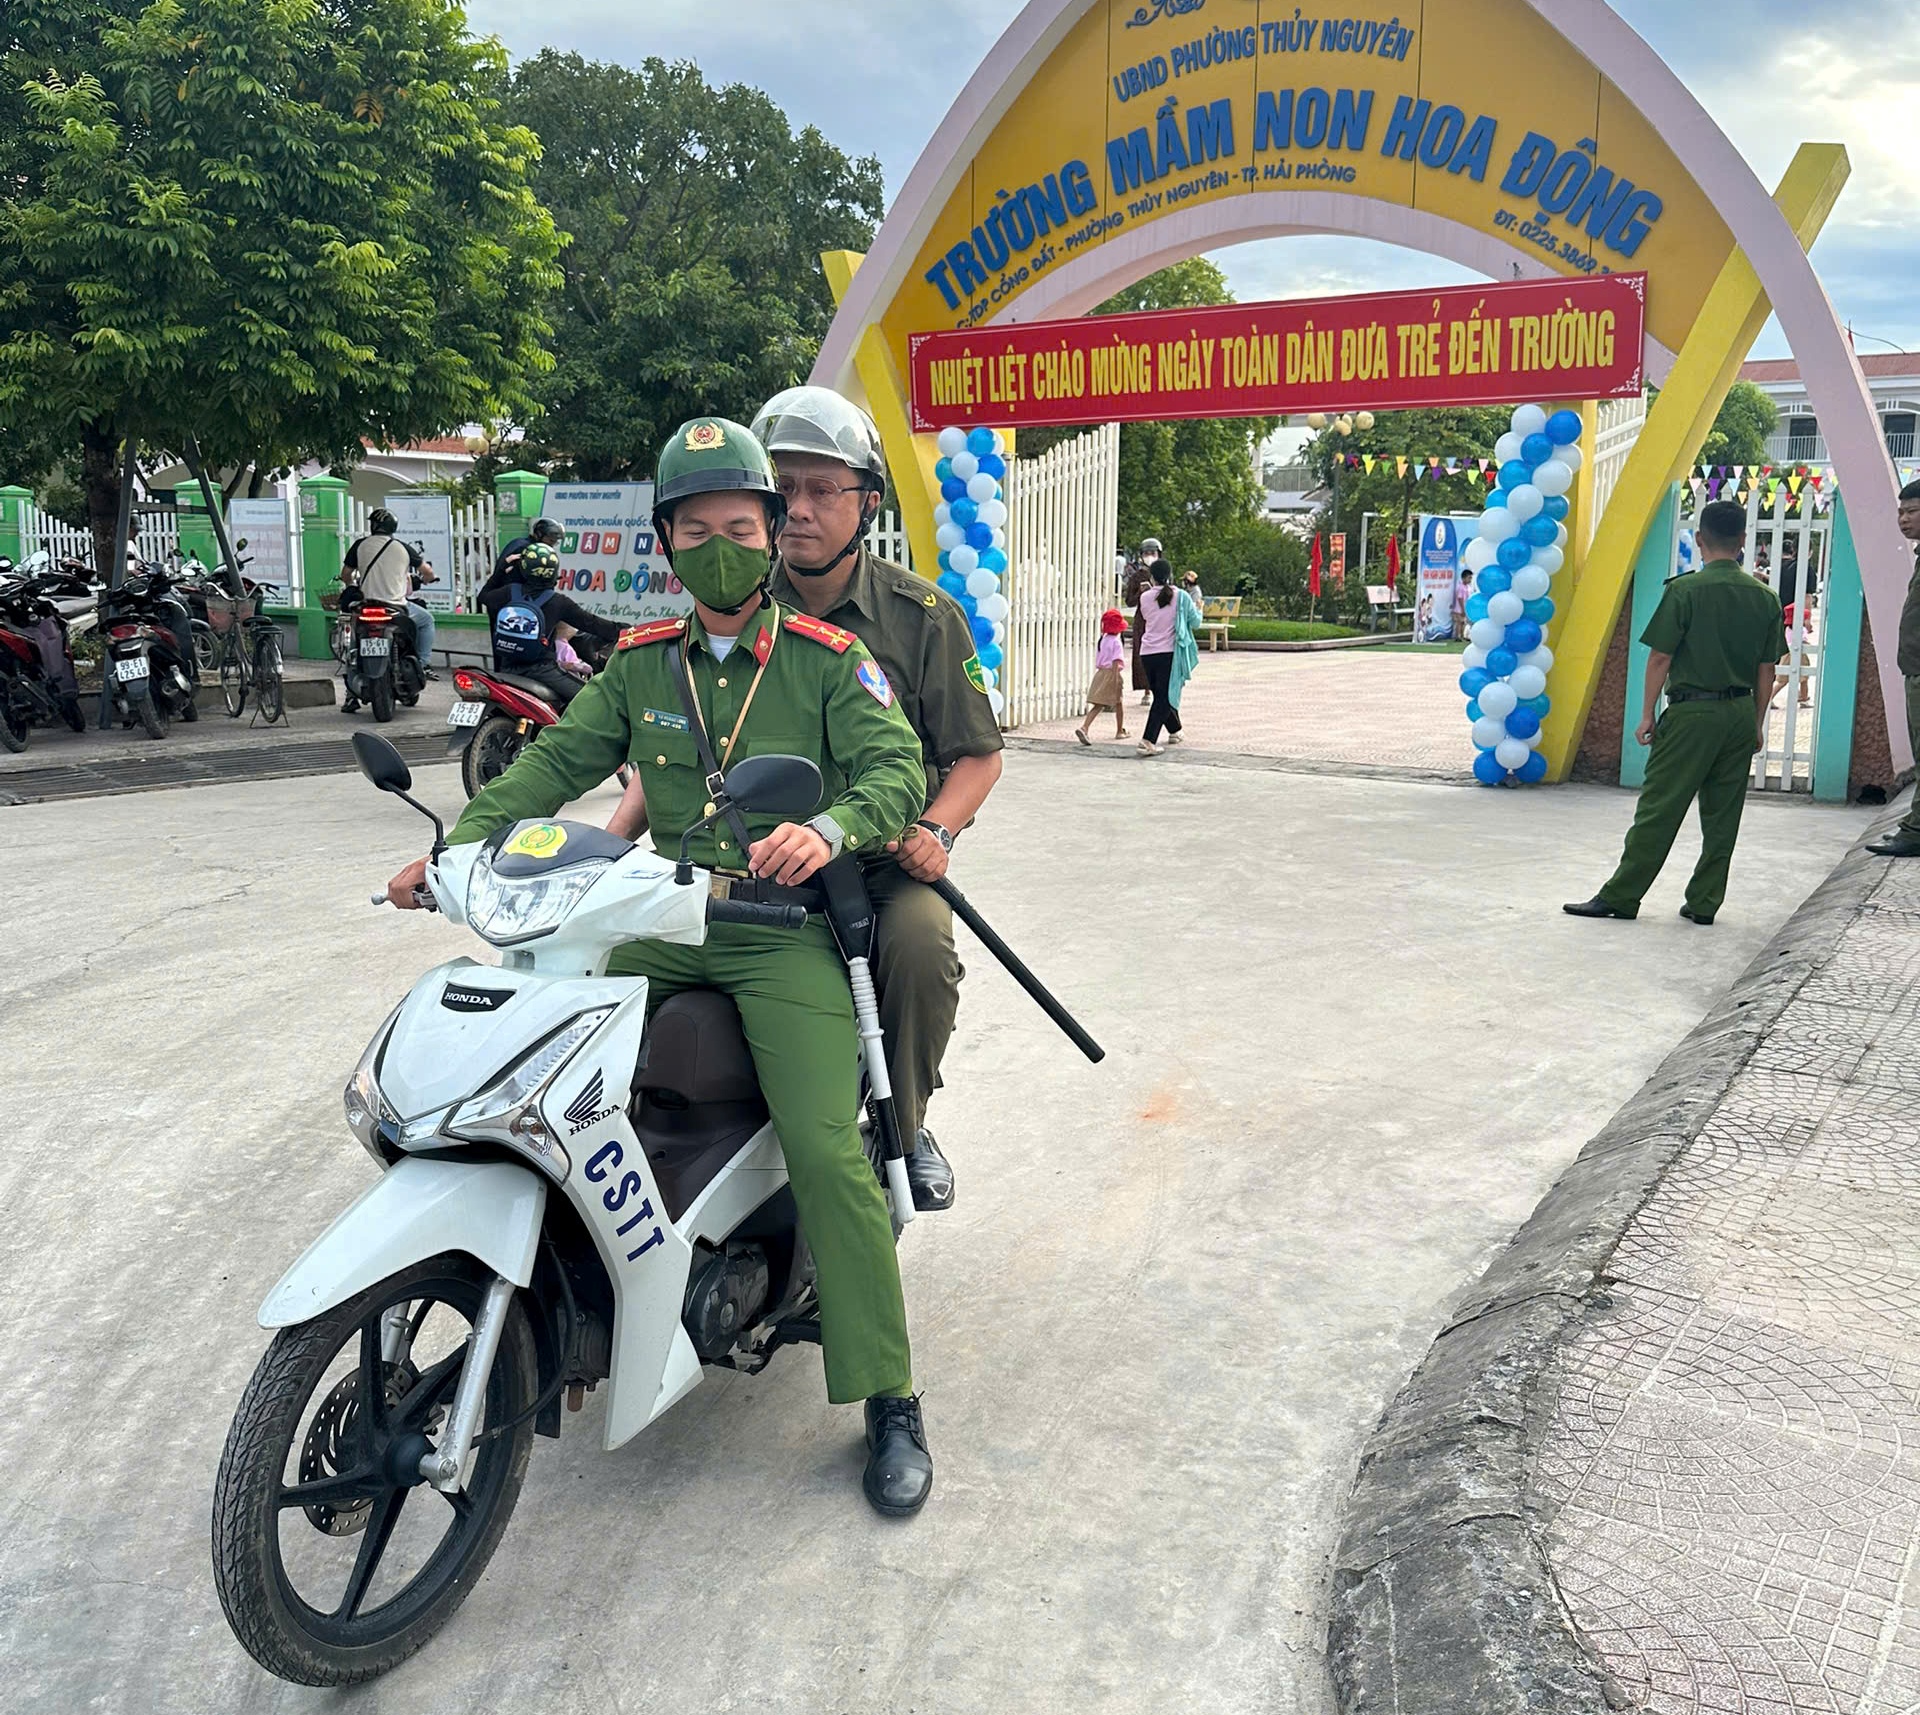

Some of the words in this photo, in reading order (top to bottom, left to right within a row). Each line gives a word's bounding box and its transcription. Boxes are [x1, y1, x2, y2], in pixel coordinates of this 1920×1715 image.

[1112, 56, 1168, 102] UBND
[1170, 26, 1256, 77] PHƯỜNG
[1260, 9, 1318, 54] THỦY
[1319, 17, 1415, 62] NGUYÊN
[924, 159, 1098, 311] TRƯỜNG
[1106, 96, 1235, 197] MẦM
[1254, 87, 1374, 152] NON
[1380, 94, 1497, 183] HOA
[1500, 131, 1663, 259] ĐỘNG
[1064, 212, 1124, 251] PHƯỜNG
[1127, 192, 1162, 219] THỦY
[1165, 170, 1229, 204] NGUYÊN
[1263, 158, 1292, 180] HẢI
[1296, 157, 1356, 183] PHÒNG
[1493, 209, 1518, 232] ĐT:
[930, 347, 984, 415] NHIỆT
[988, 344, 1028, 413] LIỆT
[1032, 339, 1085, 401] CHÀO
[1091, 333, 1151, 396] MỪNG
[1158, 329, 1216, 392] NGÀY
[1221, 324, 1279, 388] TOÀN
[1285, 320, 1334, 385] DÂN
[1340, 321, 1389, 382] ĐƯA
[1396, 300, 1441, 378] TRẺ
[1448, 299, 1501, 376] ĐẾN
[1509, 298, 1616, 372] TRƯỜNG
[565, 515, 595, 527] TRƯỜNG
[624, 514, 647, 527] QUỐC
[558, 569, 606, 592] HOA
[613, 562, 684, 601] ĐỘNG
[443, 992, 494, 1006] HONDA
[568, 1103, 622, 1136] HONDA
[584, 1140, 665, 1263] CSTT
